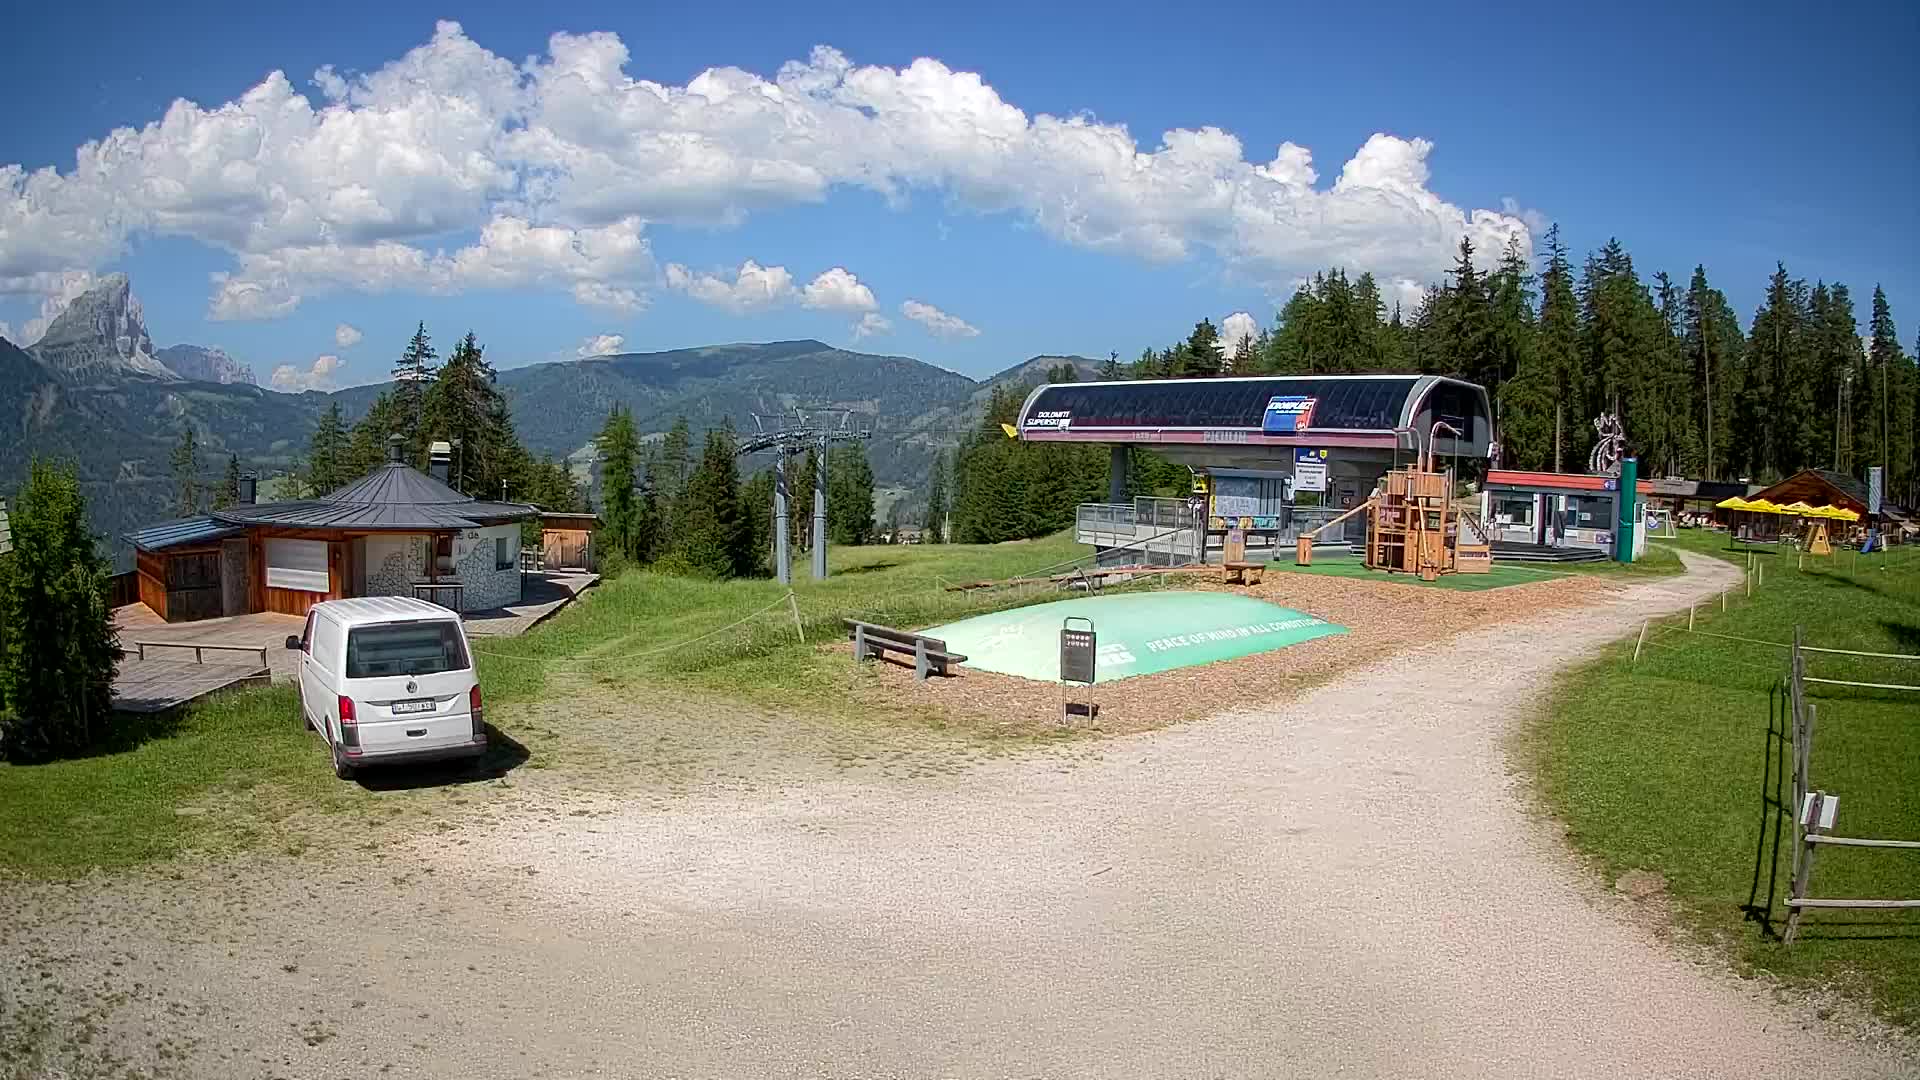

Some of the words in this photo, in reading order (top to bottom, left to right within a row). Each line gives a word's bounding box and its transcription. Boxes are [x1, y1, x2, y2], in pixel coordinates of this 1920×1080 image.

[1146, 636, 1190, 652] PEACE
[1190, 633, 1206, 643] OF
[1206, 627, 1236, 641] MIND
[1235, 627, 1250, 637] IN
[1249, 624, 1271, 633] ALL
